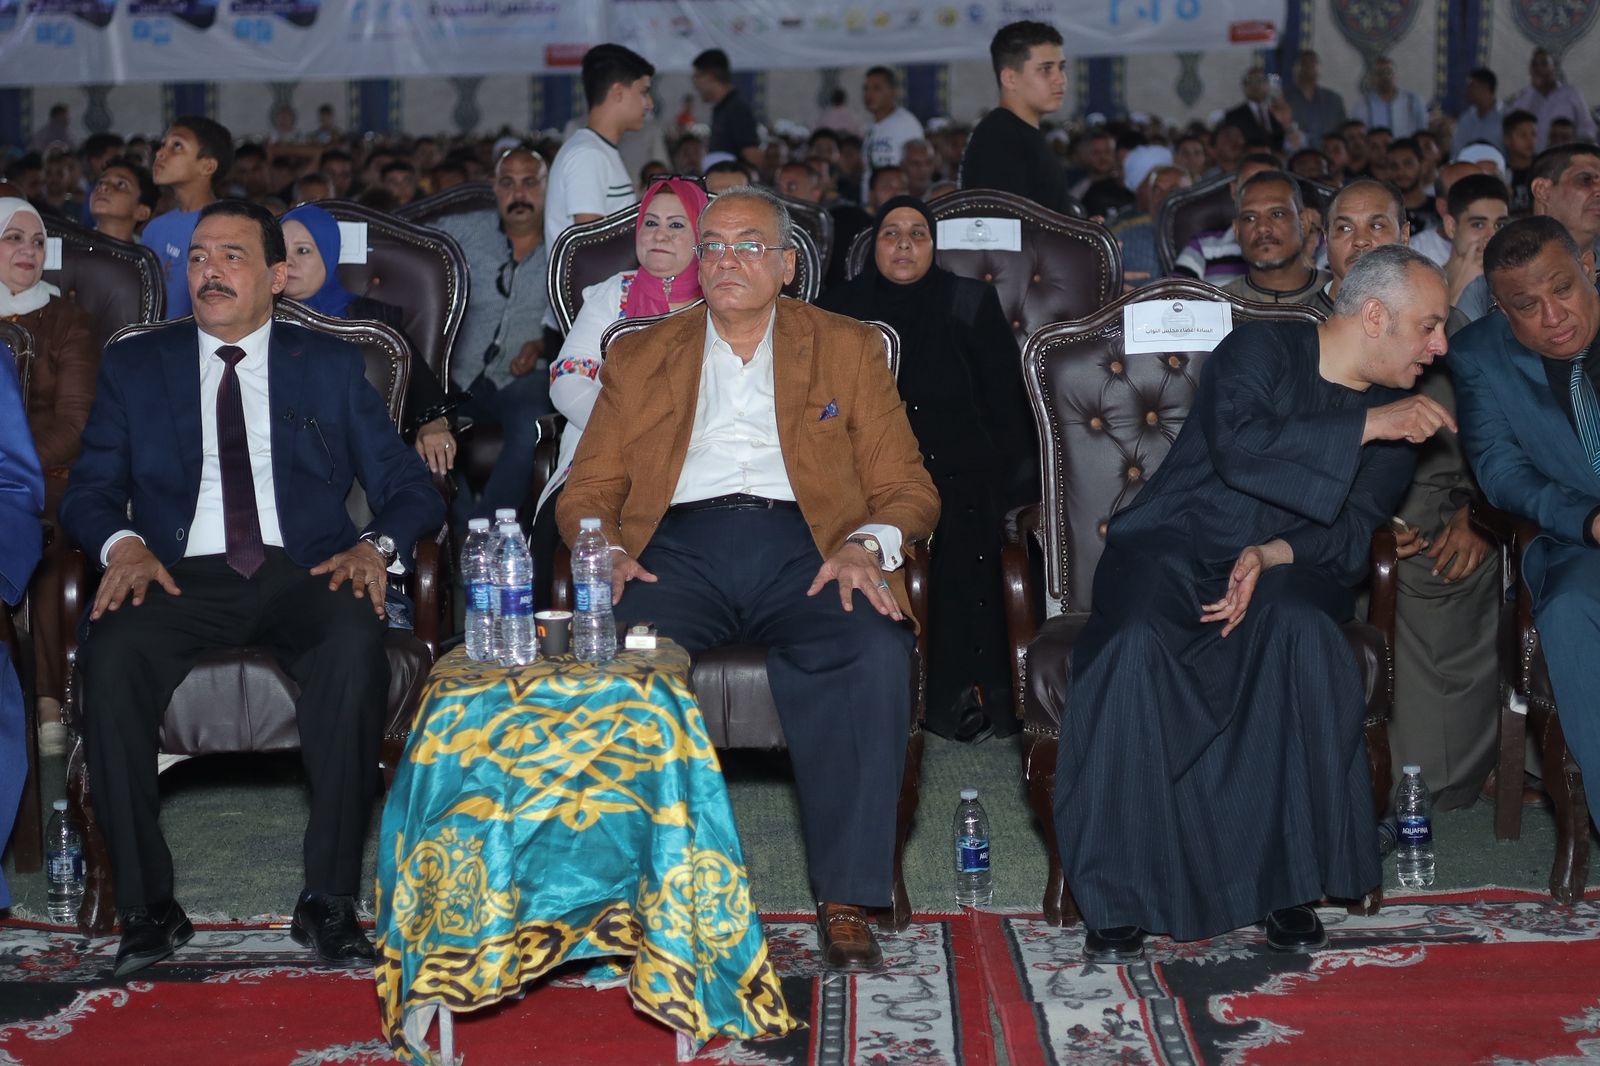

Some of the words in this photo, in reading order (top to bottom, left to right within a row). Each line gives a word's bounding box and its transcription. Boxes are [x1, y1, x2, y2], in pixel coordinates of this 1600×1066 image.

[1146, 327, 1161, 335] النواب
[1162, 327, 1179, 335] مجلس
[1402, 827, 1428, 836] AQUAFINA
